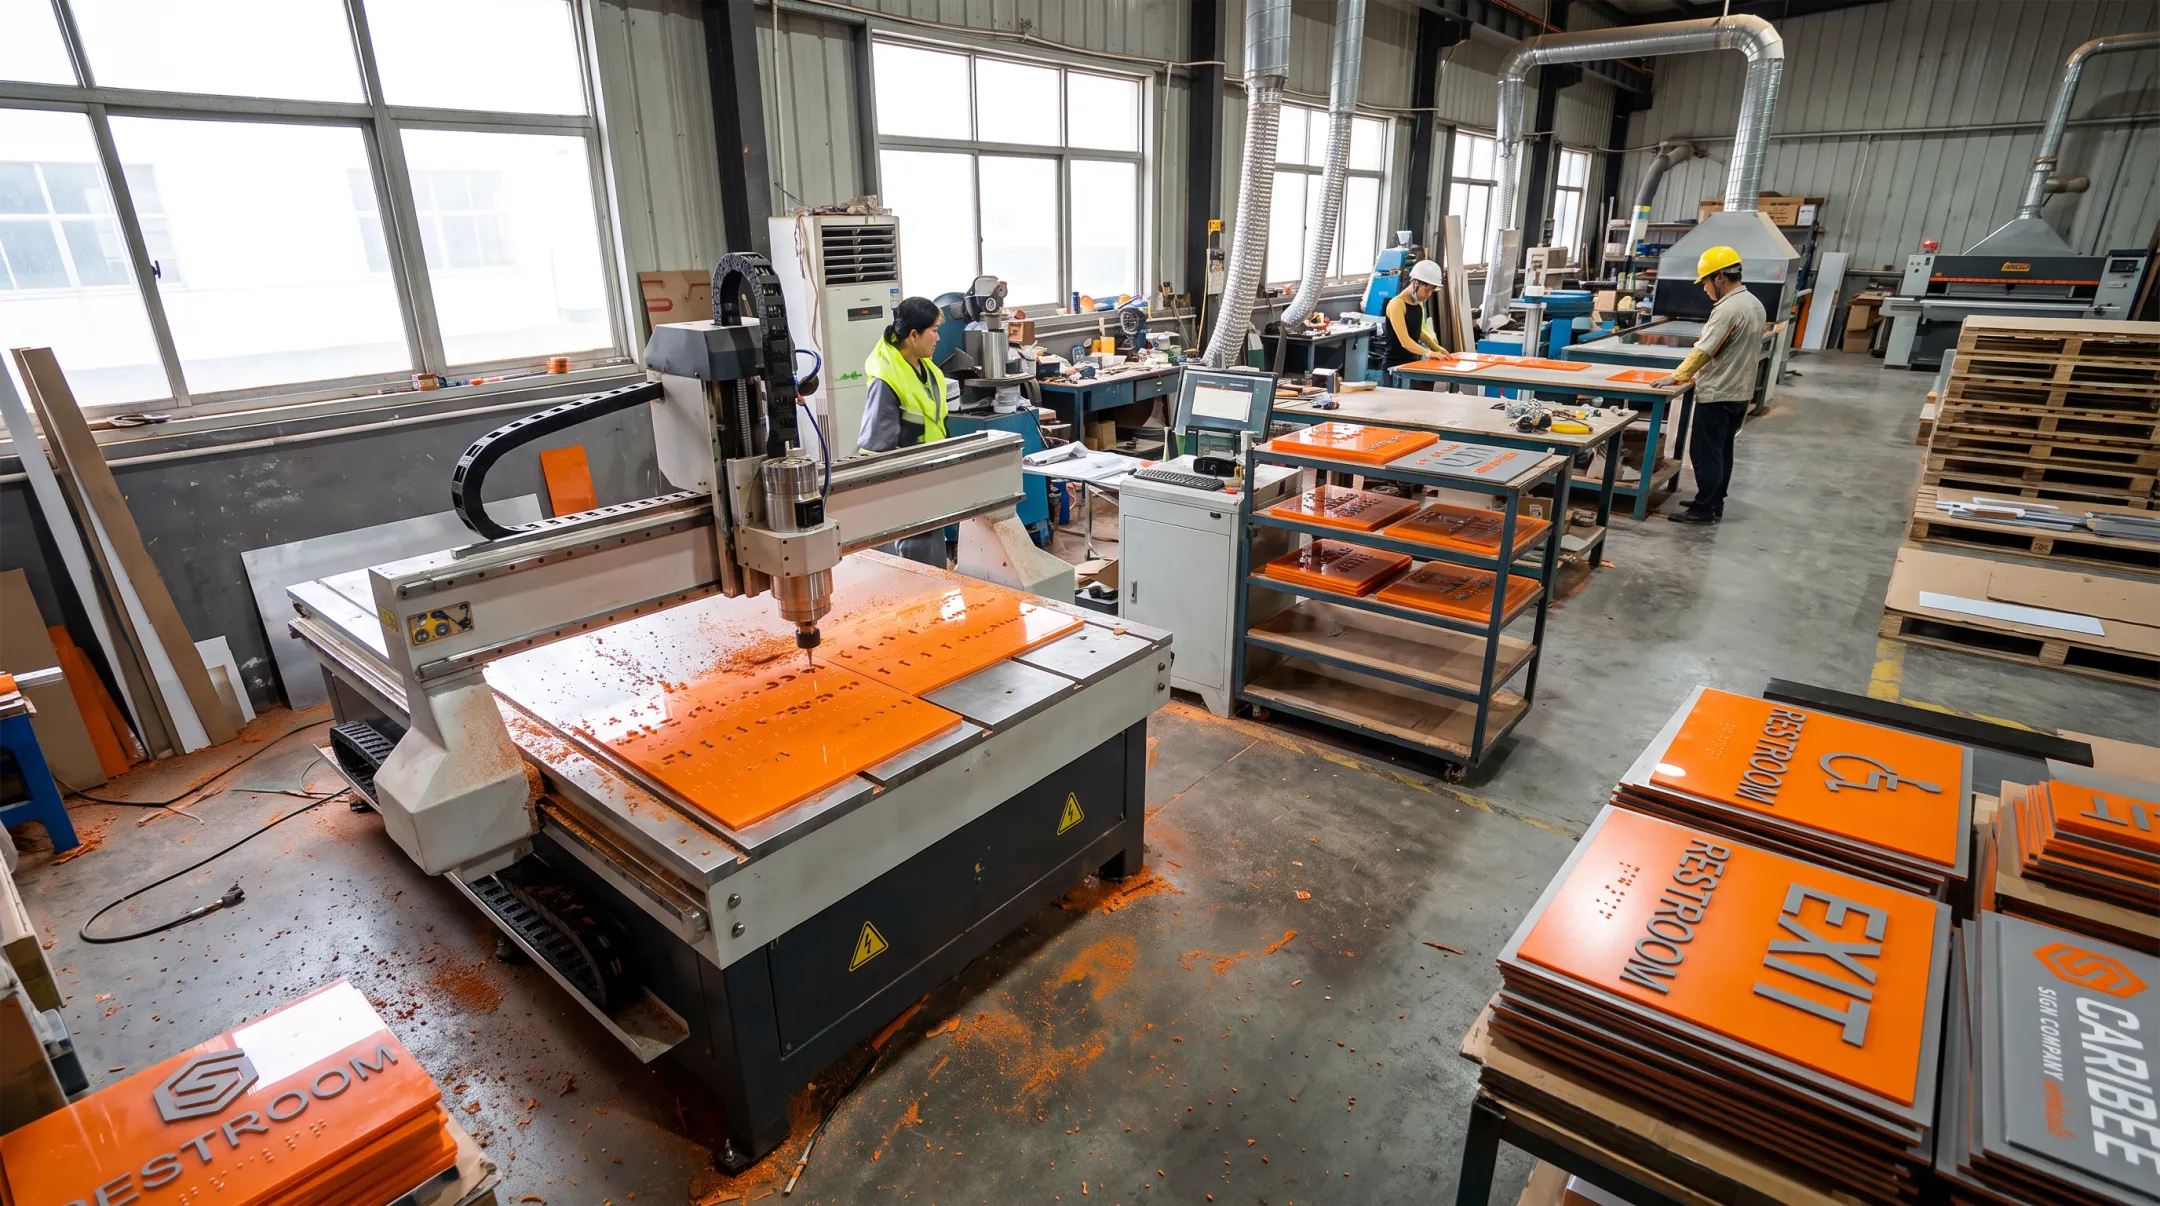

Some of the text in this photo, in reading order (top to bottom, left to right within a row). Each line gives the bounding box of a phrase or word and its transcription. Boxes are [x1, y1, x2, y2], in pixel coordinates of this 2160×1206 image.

[1735, 708, 1807, 806] RESTROOM
[2079, 796, 2160, 832] IT
[1619, 838, 1732, 995] RESTROOM
[1753, 883, 1889, 1048] EXIT
[2038, 986, 2058, 1017] SIGN
[2040, 1017, 2064, 1082] COMPANY
[63, 1043, 398, 1206] ESTROOM
[2075, 997, 2160, 1176] CARIBEE
